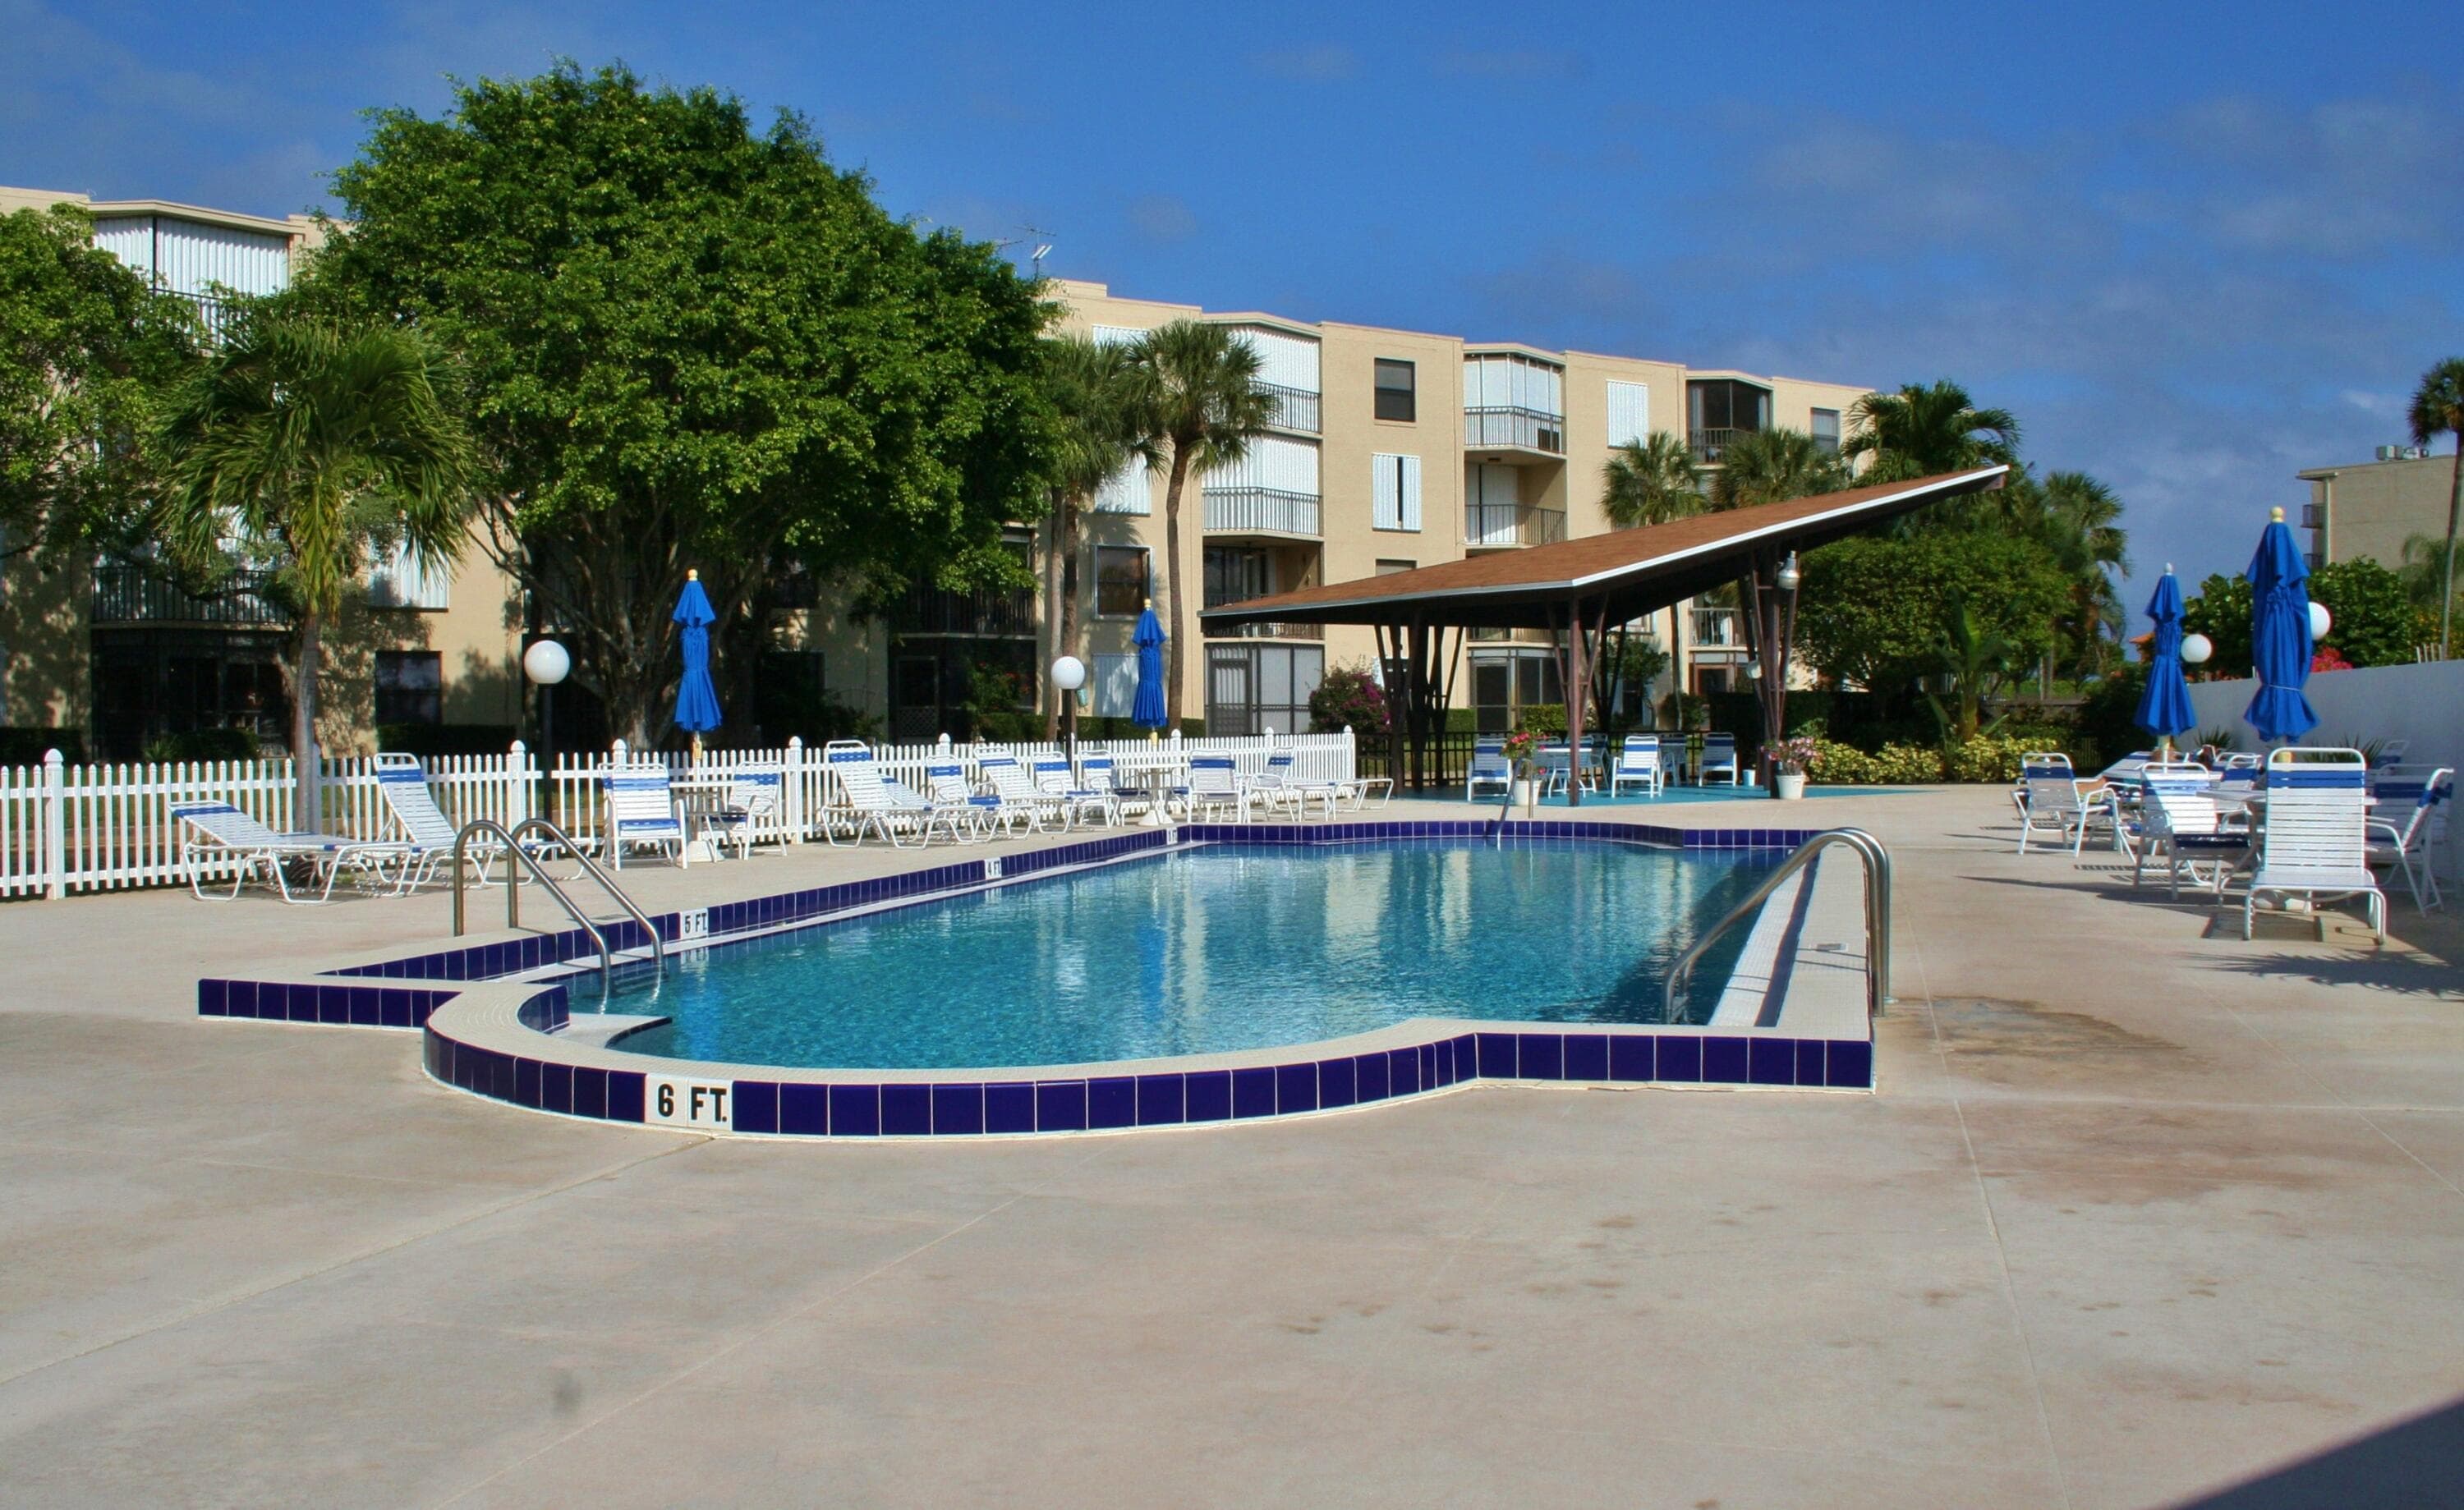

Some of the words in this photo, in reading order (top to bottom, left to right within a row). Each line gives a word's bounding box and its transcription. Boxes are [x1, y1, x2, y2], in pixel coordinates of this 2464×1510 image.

[684, 915, 691, 934] 5
[658, 1083, 674, 1118] 6
[691, 1086, 727, 1122] FT.
